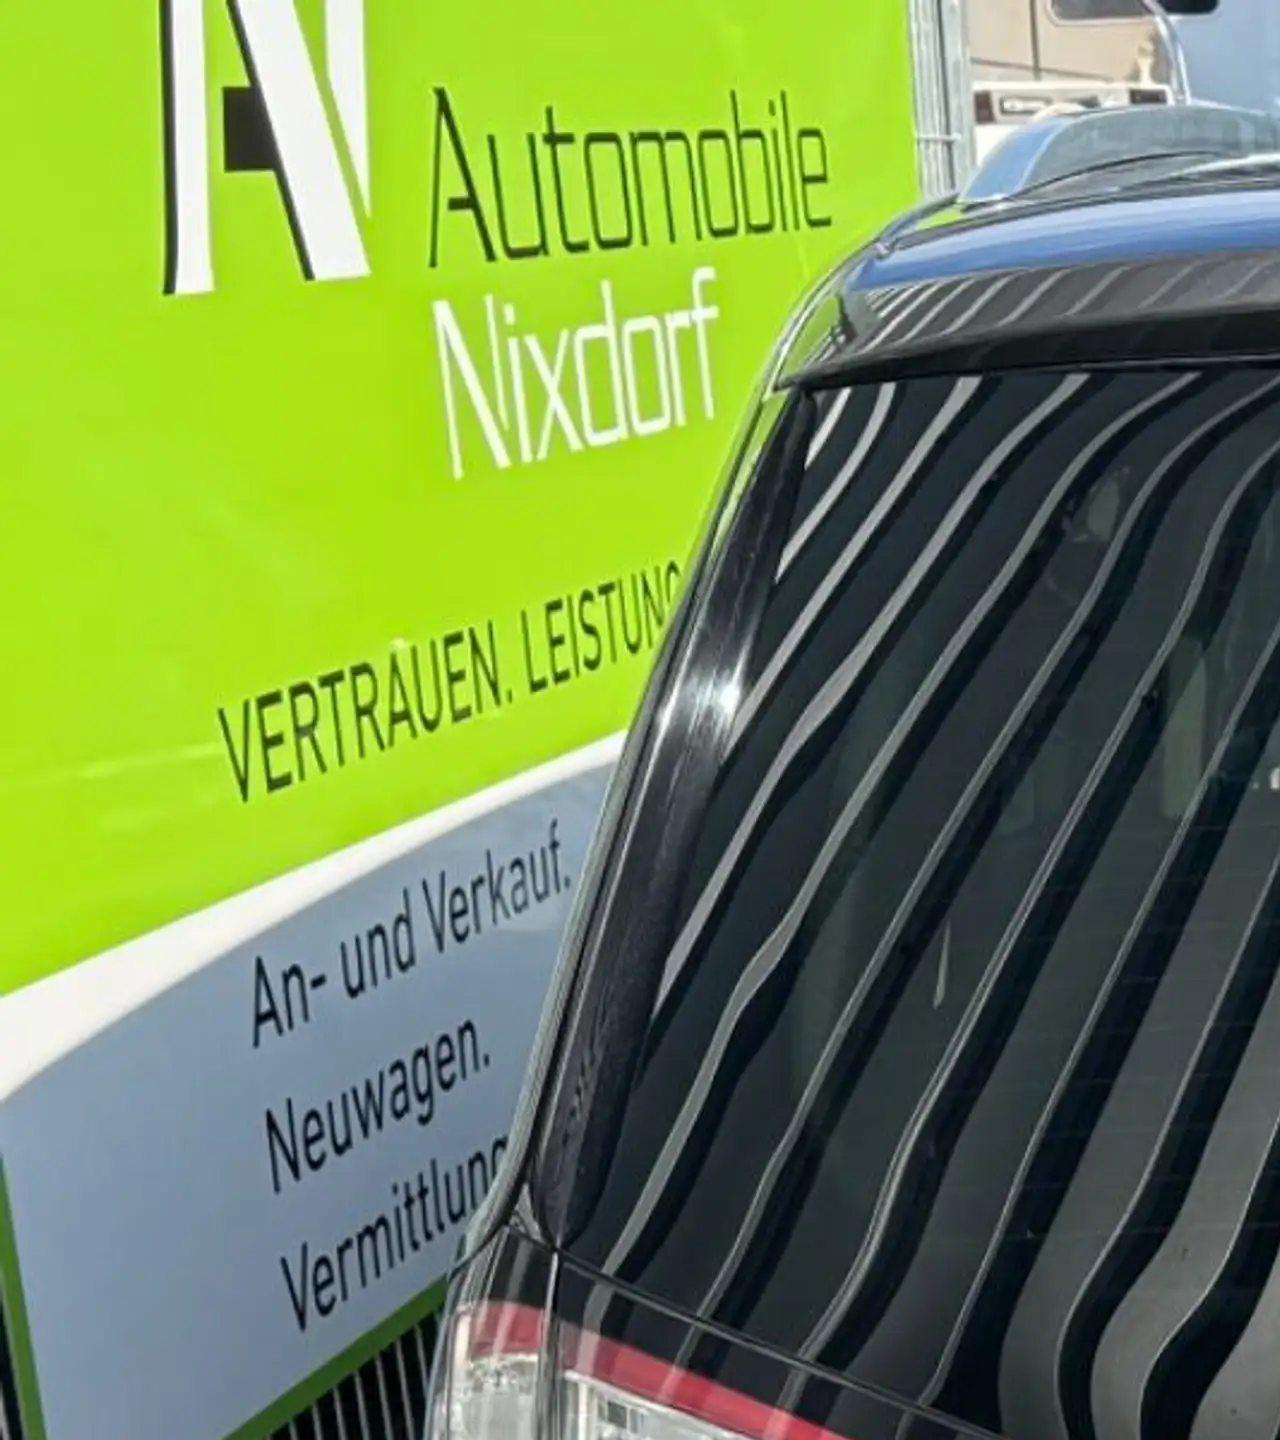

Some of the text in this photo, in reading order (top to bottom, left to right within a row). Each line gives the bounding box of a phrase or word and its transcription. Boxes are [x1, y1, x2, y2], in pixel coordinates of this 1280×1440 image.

[429, 87, 831, 267] Automobile
[432, 266, 718, 479] Nixdorf
[217, 620, 514, 804] VERTRAUEN.
[252, 820, 572, 1048] An- und Verkauf.
[265, 1018, 491, 1194] Neuwagen.
